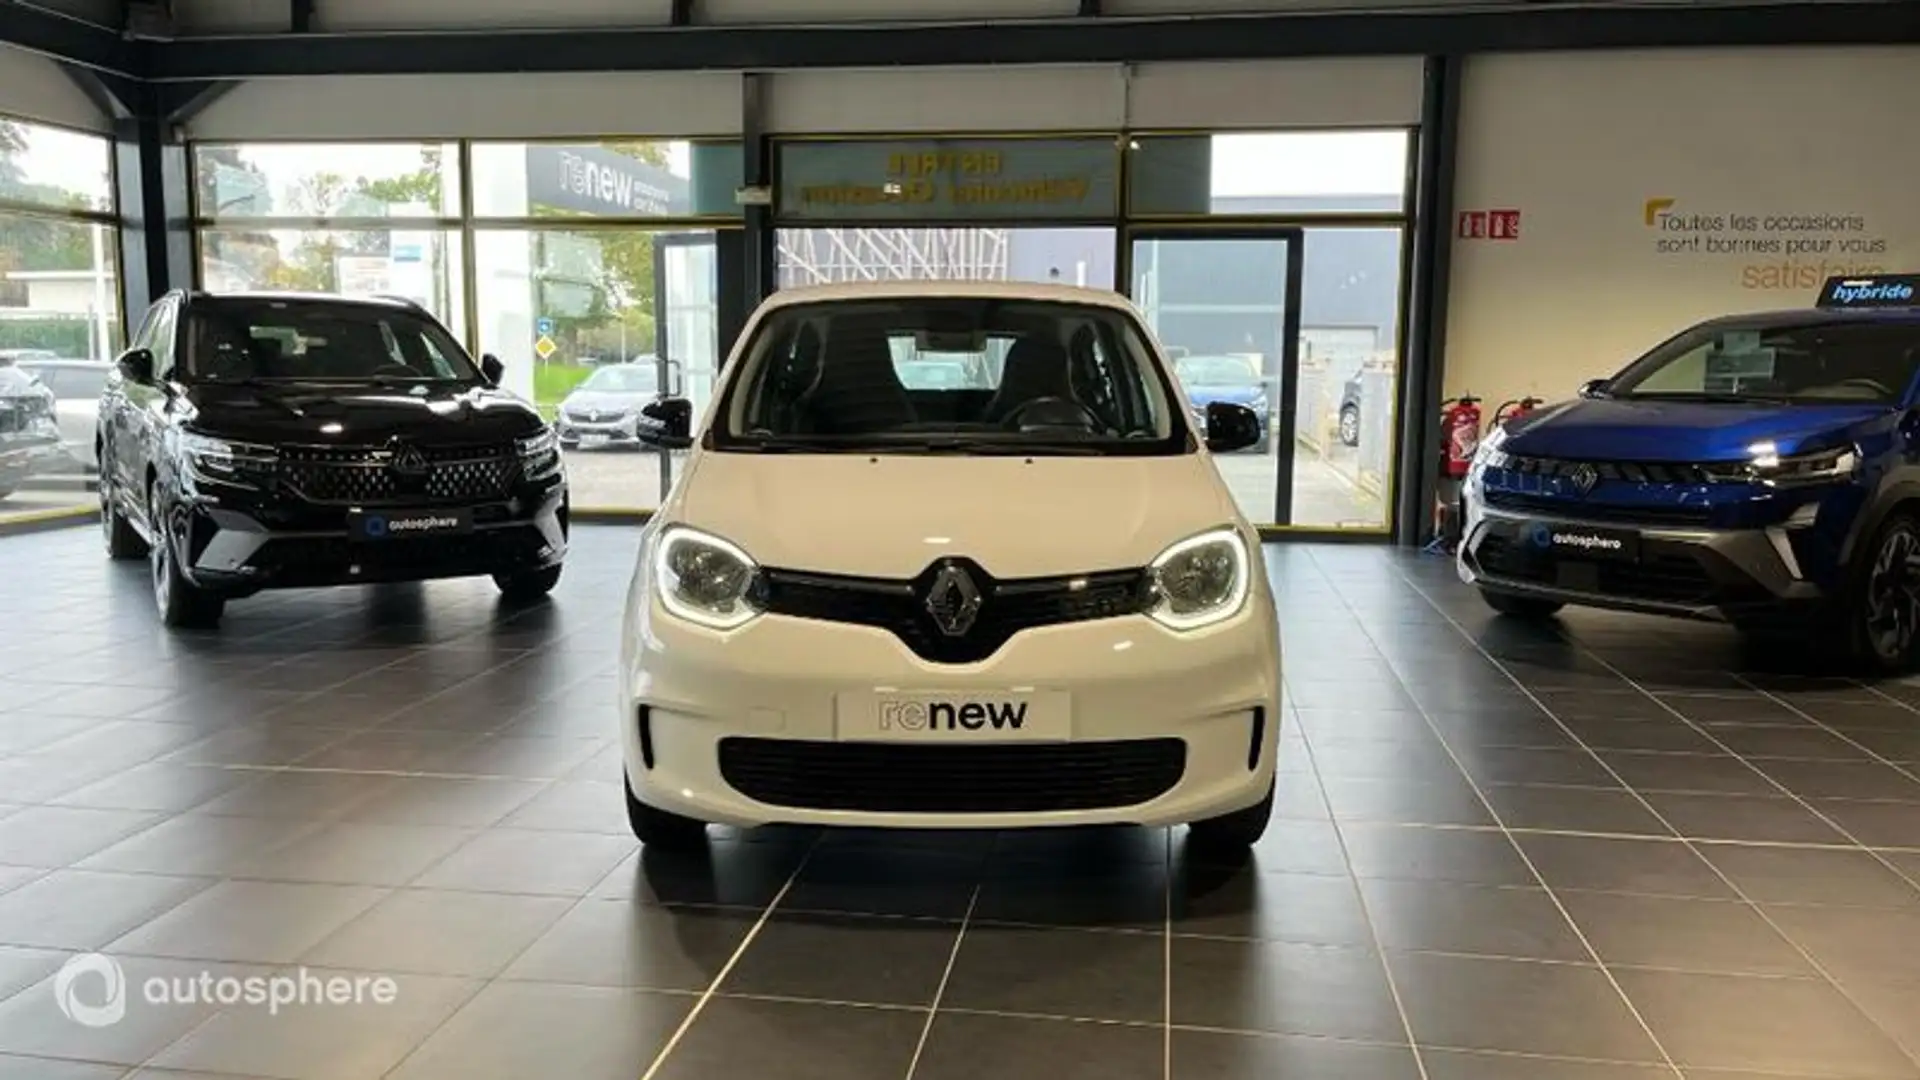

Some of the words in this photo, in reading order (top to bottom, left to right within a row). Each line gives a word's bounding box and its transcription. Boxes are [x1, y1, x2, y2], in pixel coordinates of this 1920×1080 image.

[557, 151, 634, 209] renew
[1657, 212, 1725, 232] Toutes
[1729, 212, 1758, 232] les
[1763, 213, 1865, 232] occasions
[1656, 236, 1700, 254] sont
[1705, 237, 1781, 254] bonnes
[1785, 239, 1834, 257] pour
[1837, 239, 1886, 254] vous
[1832, 282, 1913, 303] hybride
[878, 700, 1029, 731] renew
